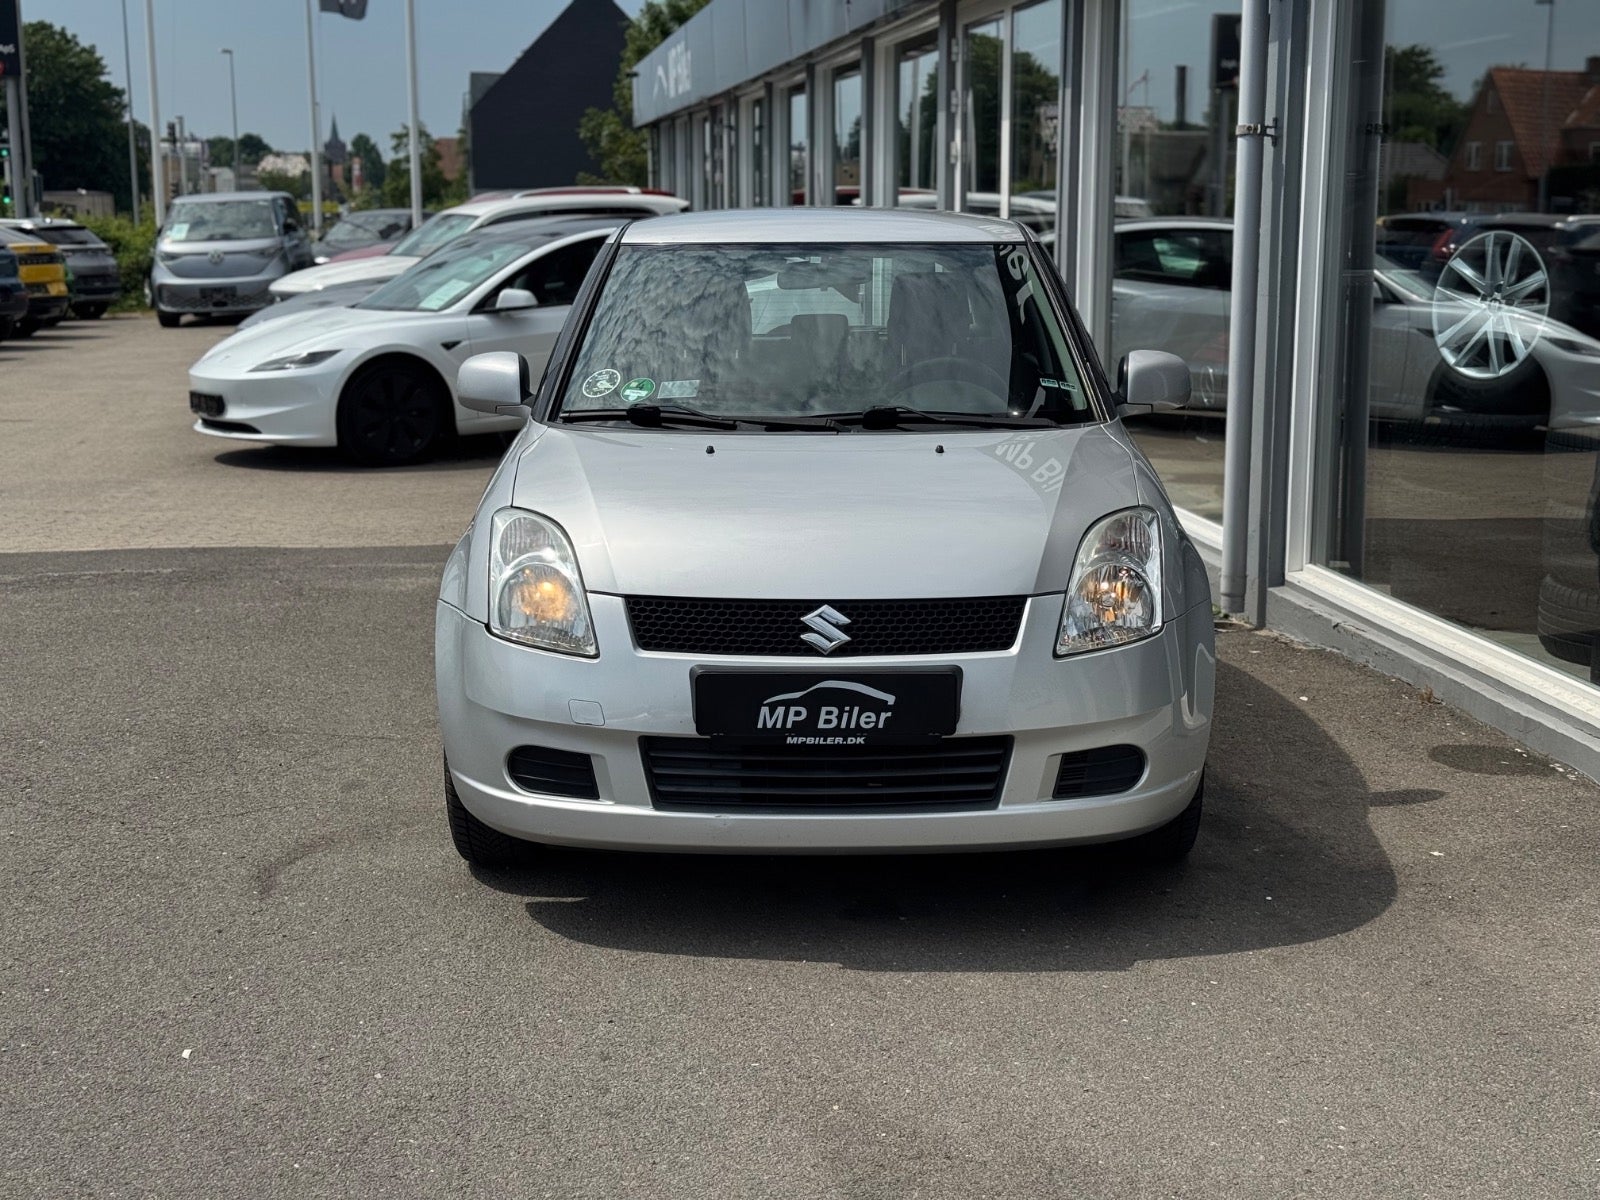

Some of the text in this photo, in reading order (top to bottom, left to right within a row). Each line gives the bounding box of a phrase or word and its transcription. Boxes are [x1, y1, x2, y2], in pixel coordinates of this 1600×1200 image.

[757, 706, 892, 729] MP Biler
[786, 736, 866, 745] MPBILER.DK
